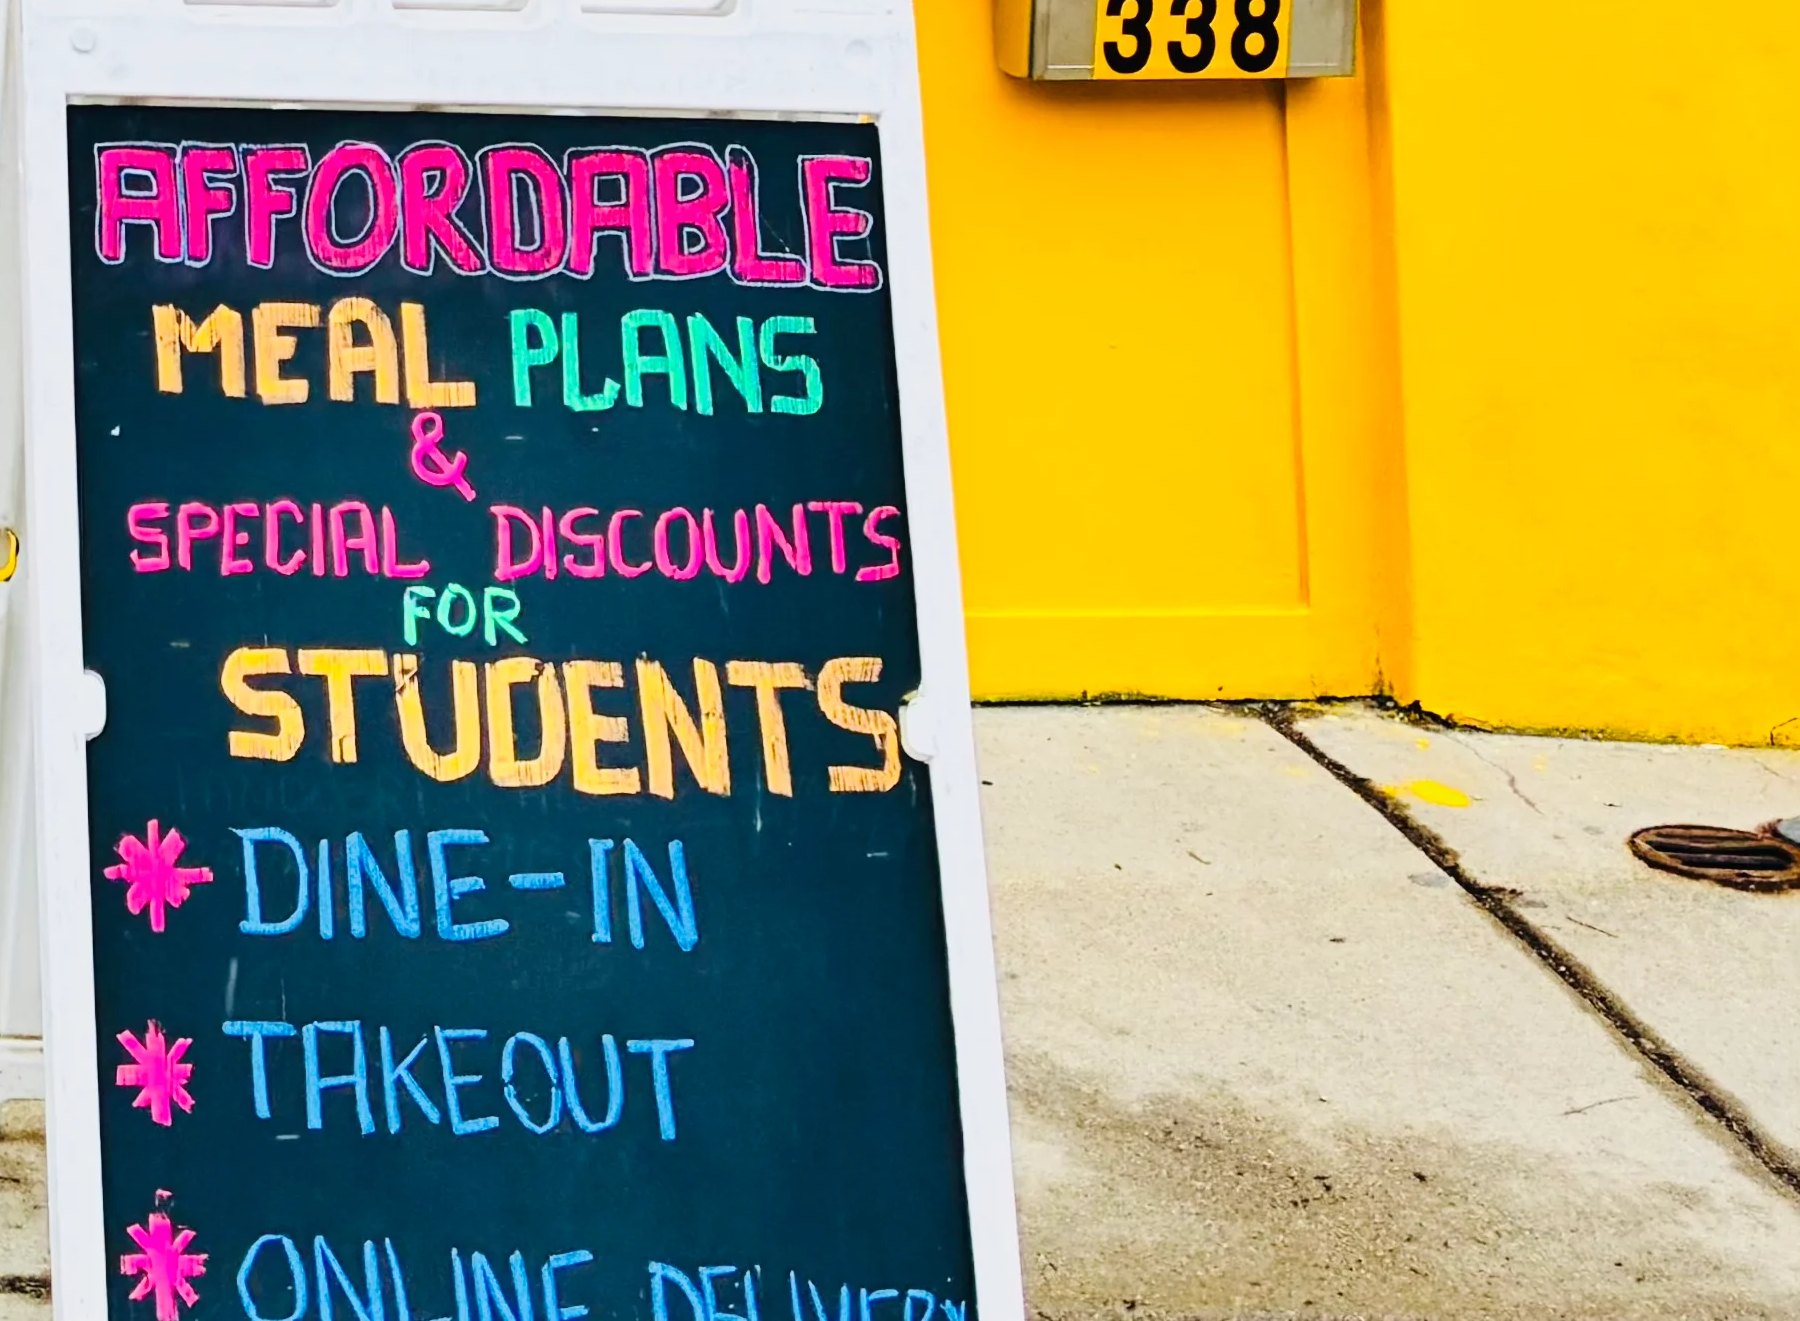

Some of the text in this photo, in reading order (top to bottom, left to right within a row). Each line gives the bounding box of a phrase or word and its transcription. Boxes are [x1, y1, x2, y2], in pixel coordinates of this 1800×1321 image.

[93, 141, 883, 295] AFFORDABLE
[152, 296, 825, 416] MEAL PLANS
[410, 410, 476, 501] &
[126, 500, 903, 585] SPECIAL DISCOUNTS
[402, 583, 529, 647] FOR
[220, 647, 903, 799] STUDENTS
[233, 825, 702, 954] DINE-IN
[222, 1017, 696, 1143] TAKEOUT
[236, 1232, 596, 1321] ONLINE
